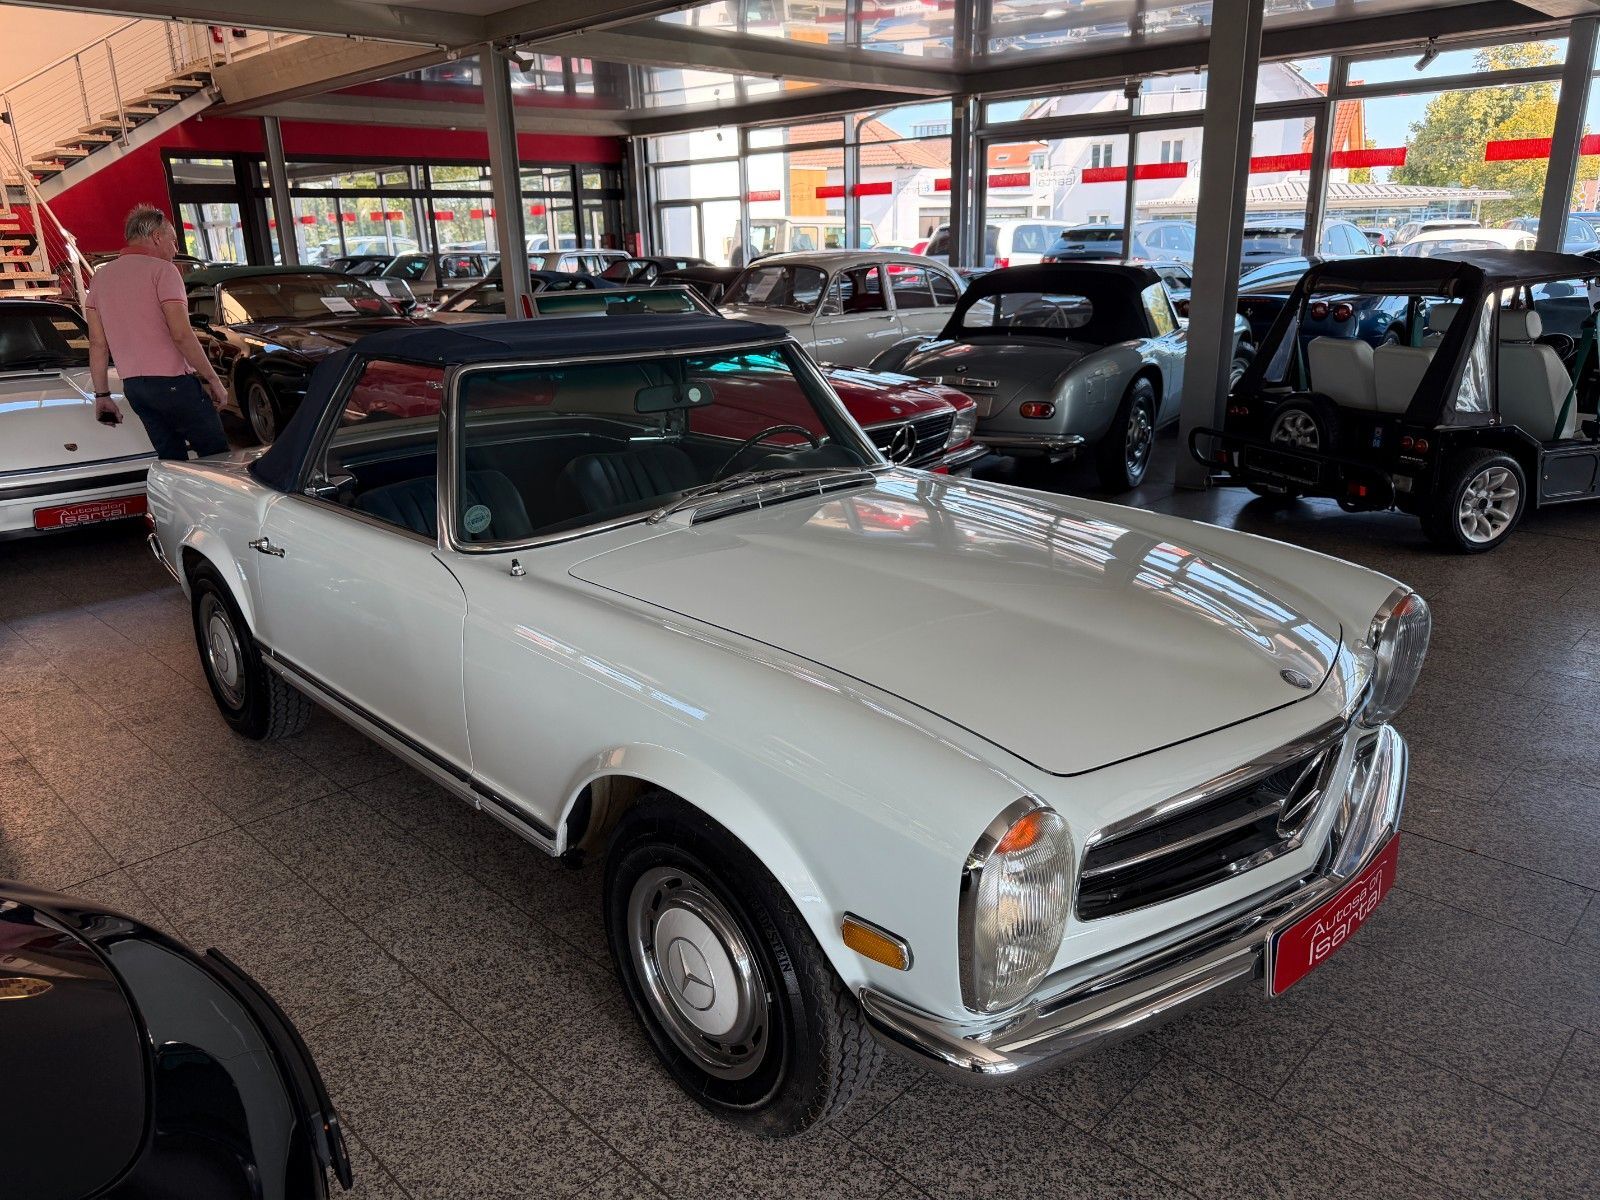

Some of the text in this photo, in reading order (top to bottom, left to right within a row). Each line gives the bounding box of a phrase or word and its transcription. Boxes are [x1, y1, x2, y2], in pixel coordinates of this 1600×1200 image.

[61, 506, 126, 525] Isartal
[62, 503, 125, 515] Autosalon
[1308, 880, 1383, 966] Isartal
[1312, 870, 1382, 938] Autosaon
